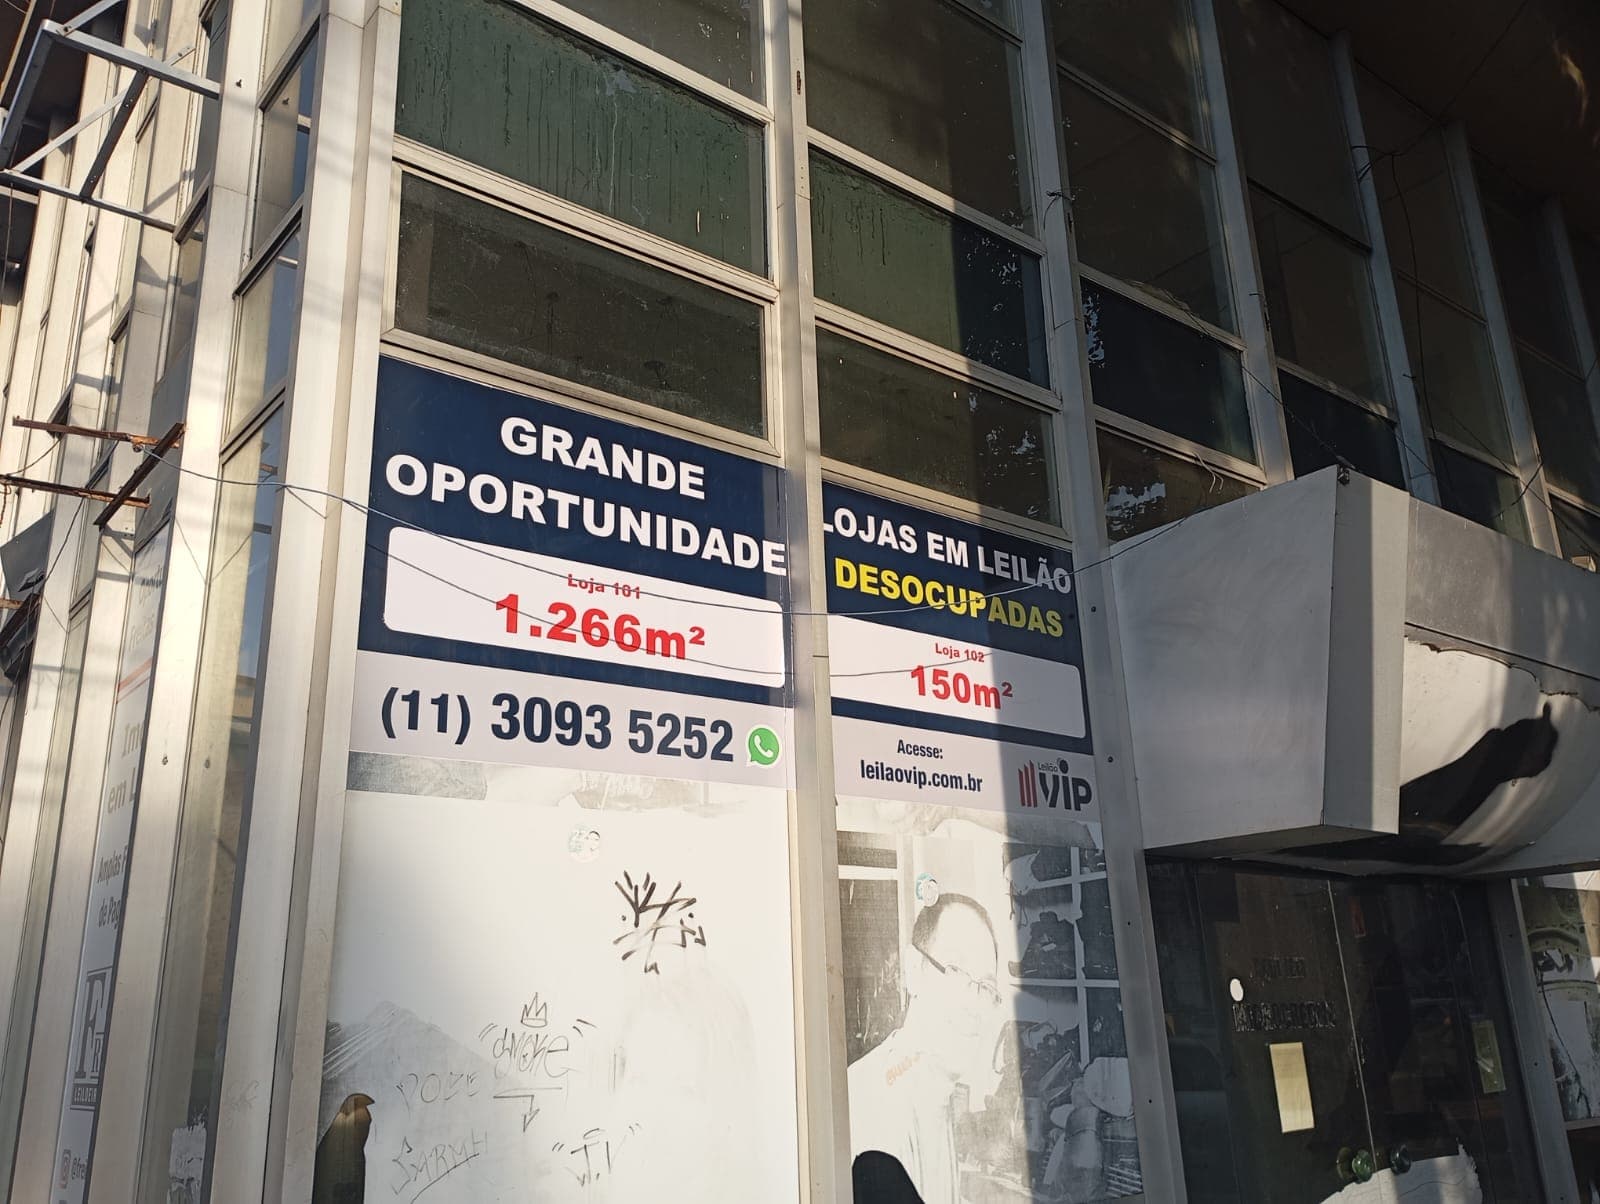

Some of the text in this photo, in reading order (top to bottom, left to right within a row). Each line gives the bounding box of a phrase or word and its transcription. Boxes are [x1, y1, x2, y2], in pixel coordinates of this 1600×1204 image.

[500, 416, 706, 500] GRANDE
[385, 454, 788, 577] OPORTUNIDADE
[567, 573, 641, 599] Loja 101
[926, 531, 969, 568] EM
[977, 545, 1072, 594] LEILÃO
[834, 557, 1064, 637] DESOCUPADAS
[935, 642, 985, 663] Loja 102
[380, 687, 734, 762] (11) 3093 5252
[897, 739, 944, 759] Acesse:
[860, 759, 983, 793] leilaovip.com.br
